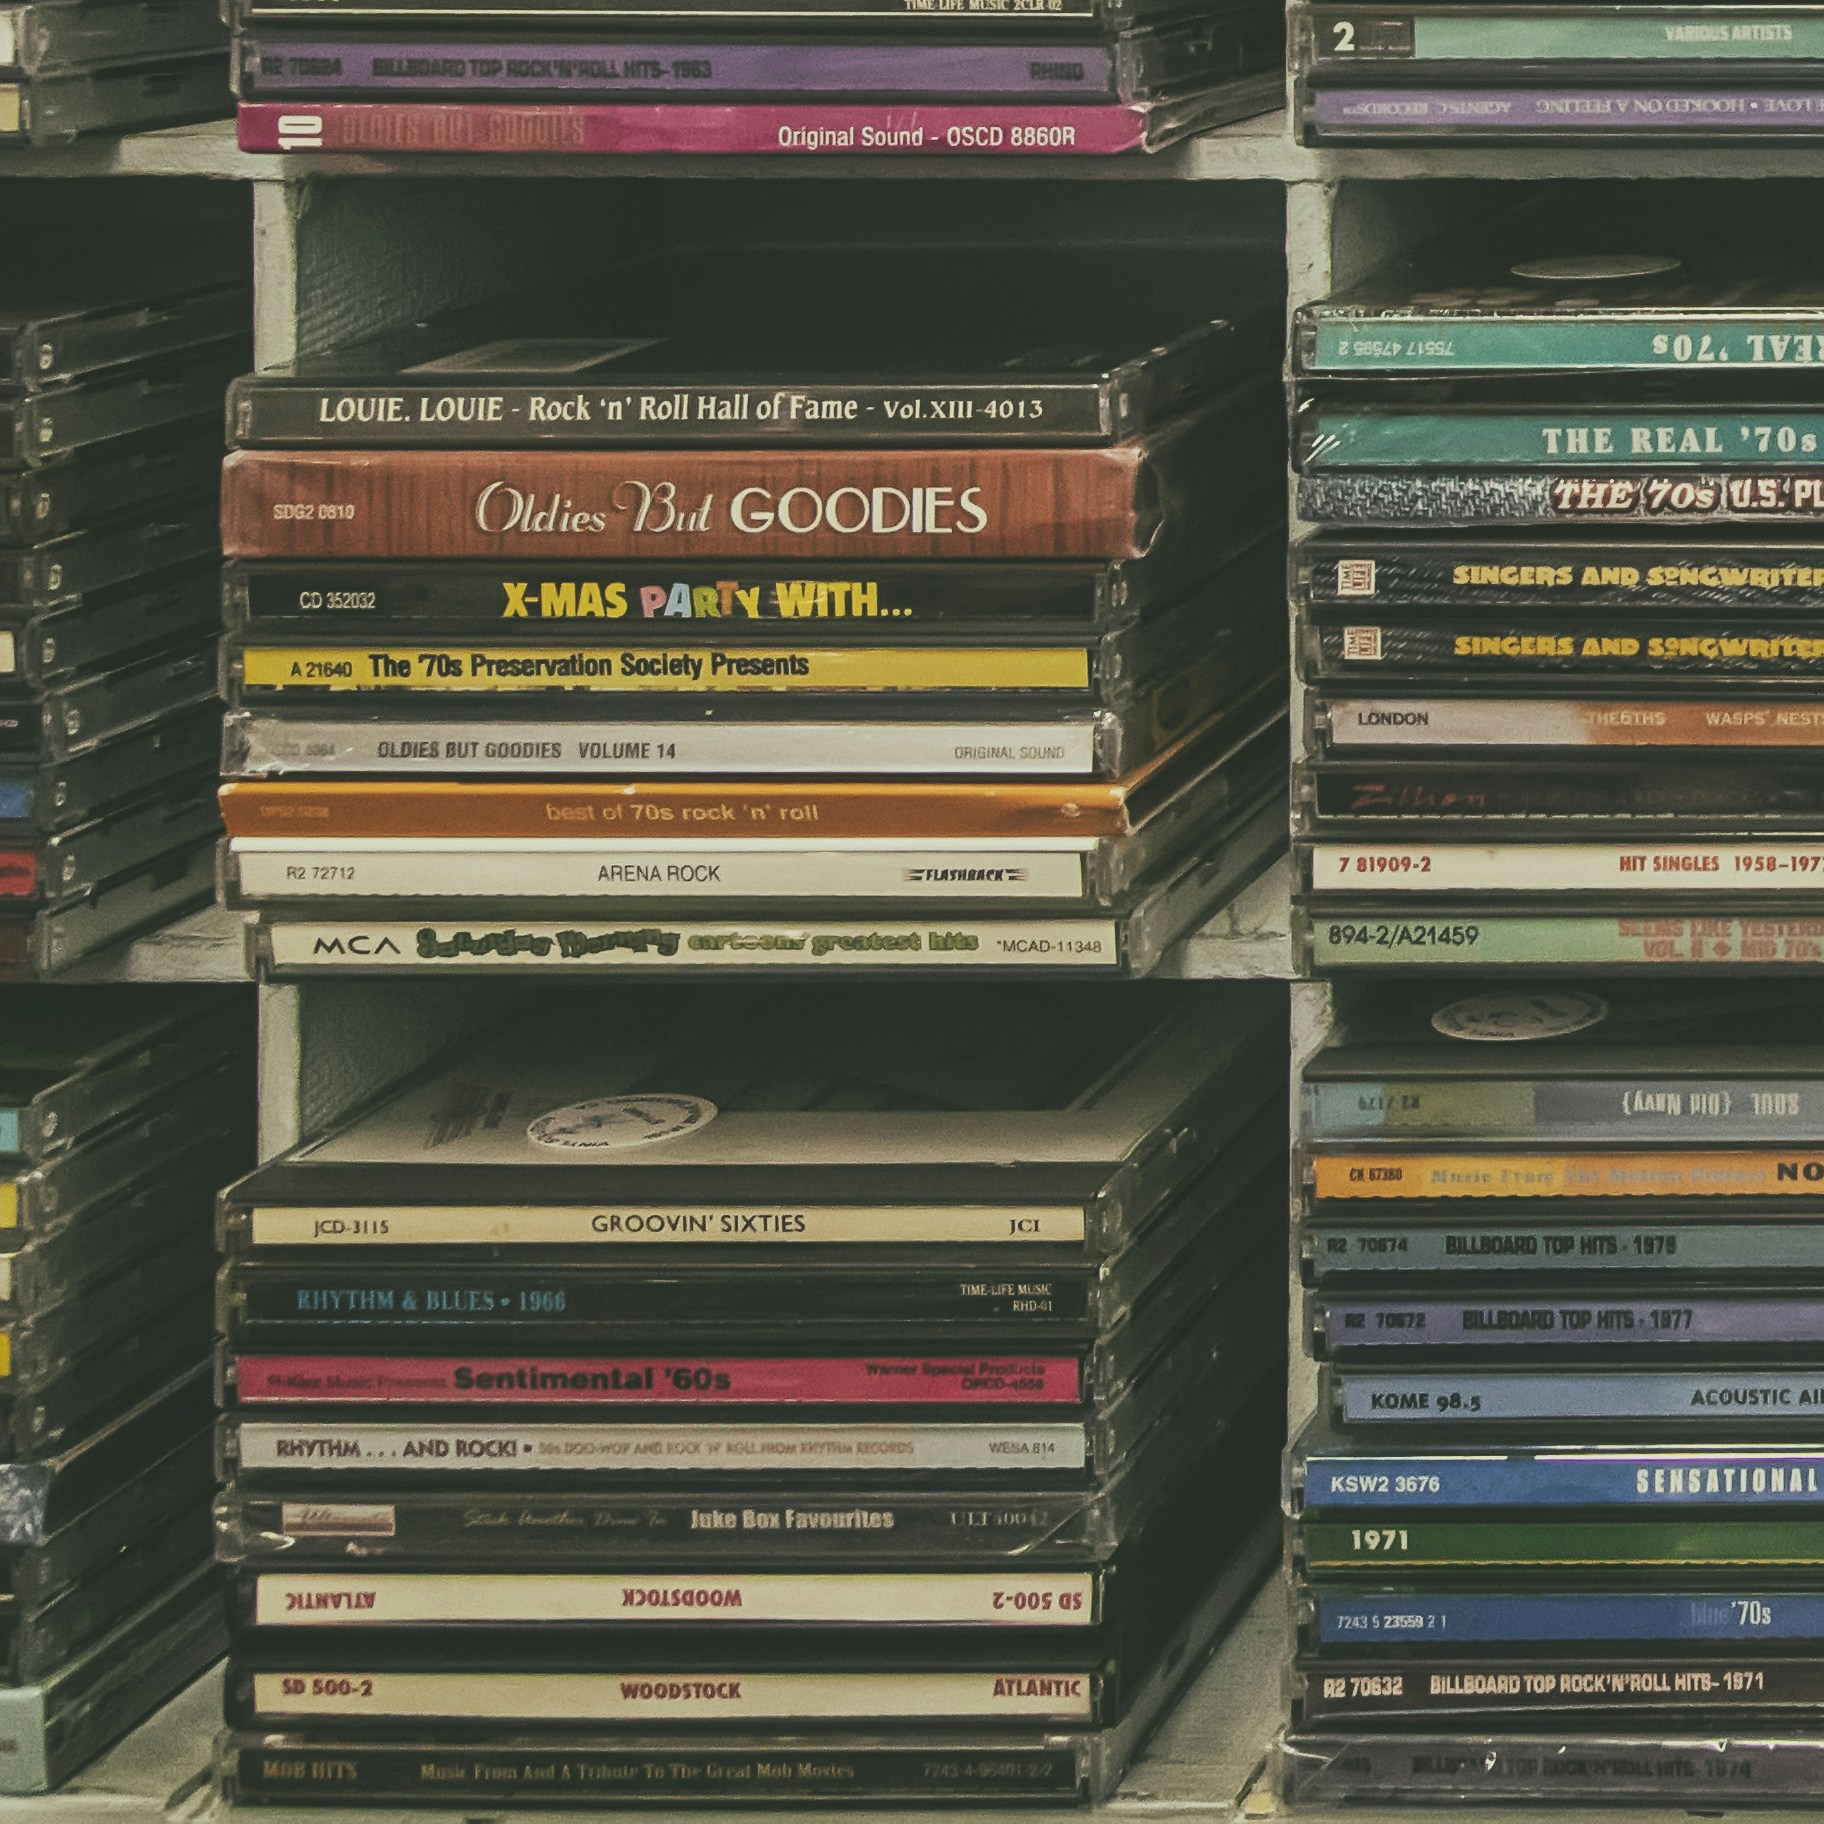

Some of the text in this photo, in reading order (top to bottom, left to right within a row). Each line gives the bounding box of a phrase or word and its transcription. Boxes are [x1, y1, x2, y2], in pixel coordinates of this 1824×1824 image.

[1543, 427, 1817, 455] THE REAL '70s
[476, 480, 988, 534] Oldies But GOODIES
[502, 583, 913, 620] X-MAS PARTY WITH...
[1339, 856, 1350, 873] 7
[1356, 856, 1432, 873] 81909-2
[1619, 856, 1647, 872] HIT
[1653, 856, 1720, 872] SINGLES
[1328, 924, 1480, 946] 894-2/A21459
[314, 1211, 1040, 1238] JCD-3115 GROOVIN' SIXTIES JCI
[1371, 1392, 1430, 1410] KOME
[1436, 1394, 1481, 1414] 98.5
[1690, 1388, 1791, 1406] ACOUSTIC
[1330, 1475, 1440, 1493] KSW2 3676
[1351, 1529, 1408, 1551] 1971
